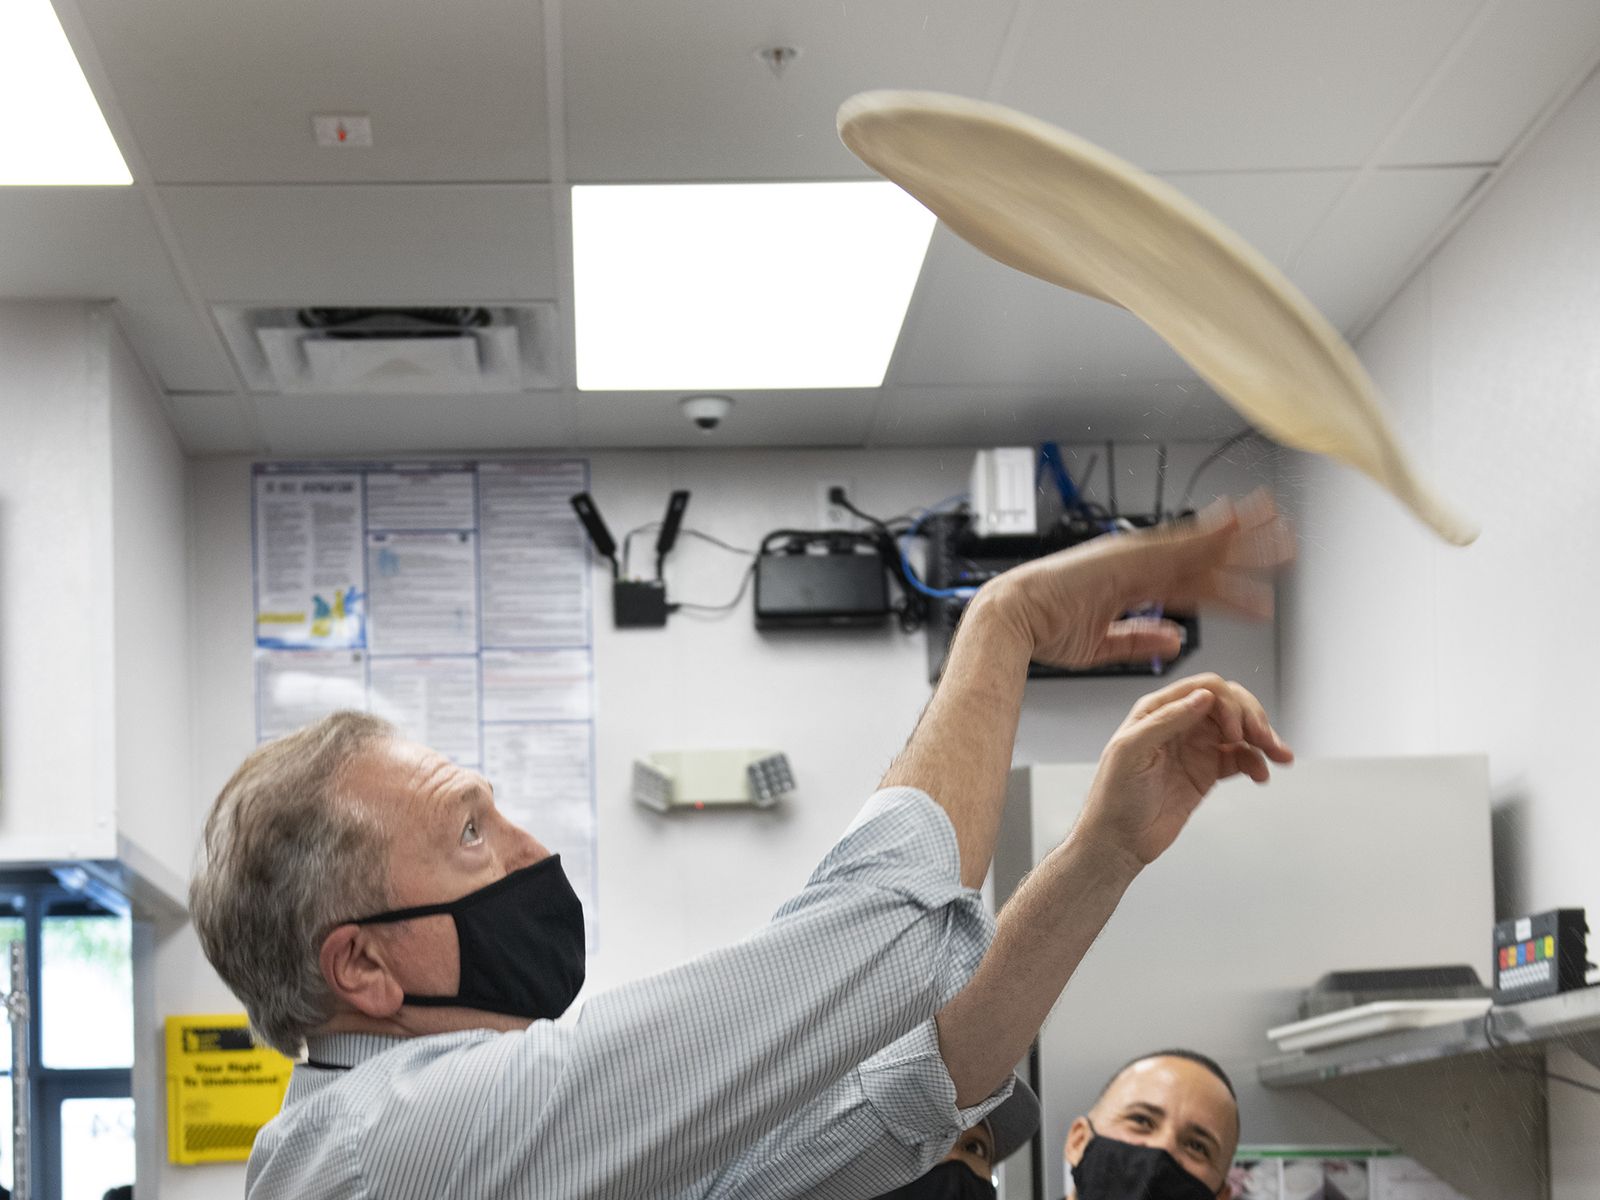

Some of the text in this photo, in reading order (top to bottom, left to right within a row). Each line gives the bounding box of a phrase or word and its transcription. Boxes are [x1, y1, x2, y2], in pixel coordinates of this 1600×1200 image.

[194, 1062, 261, 1073] Your Right
[202, 1075, 278, 1086] Understand
